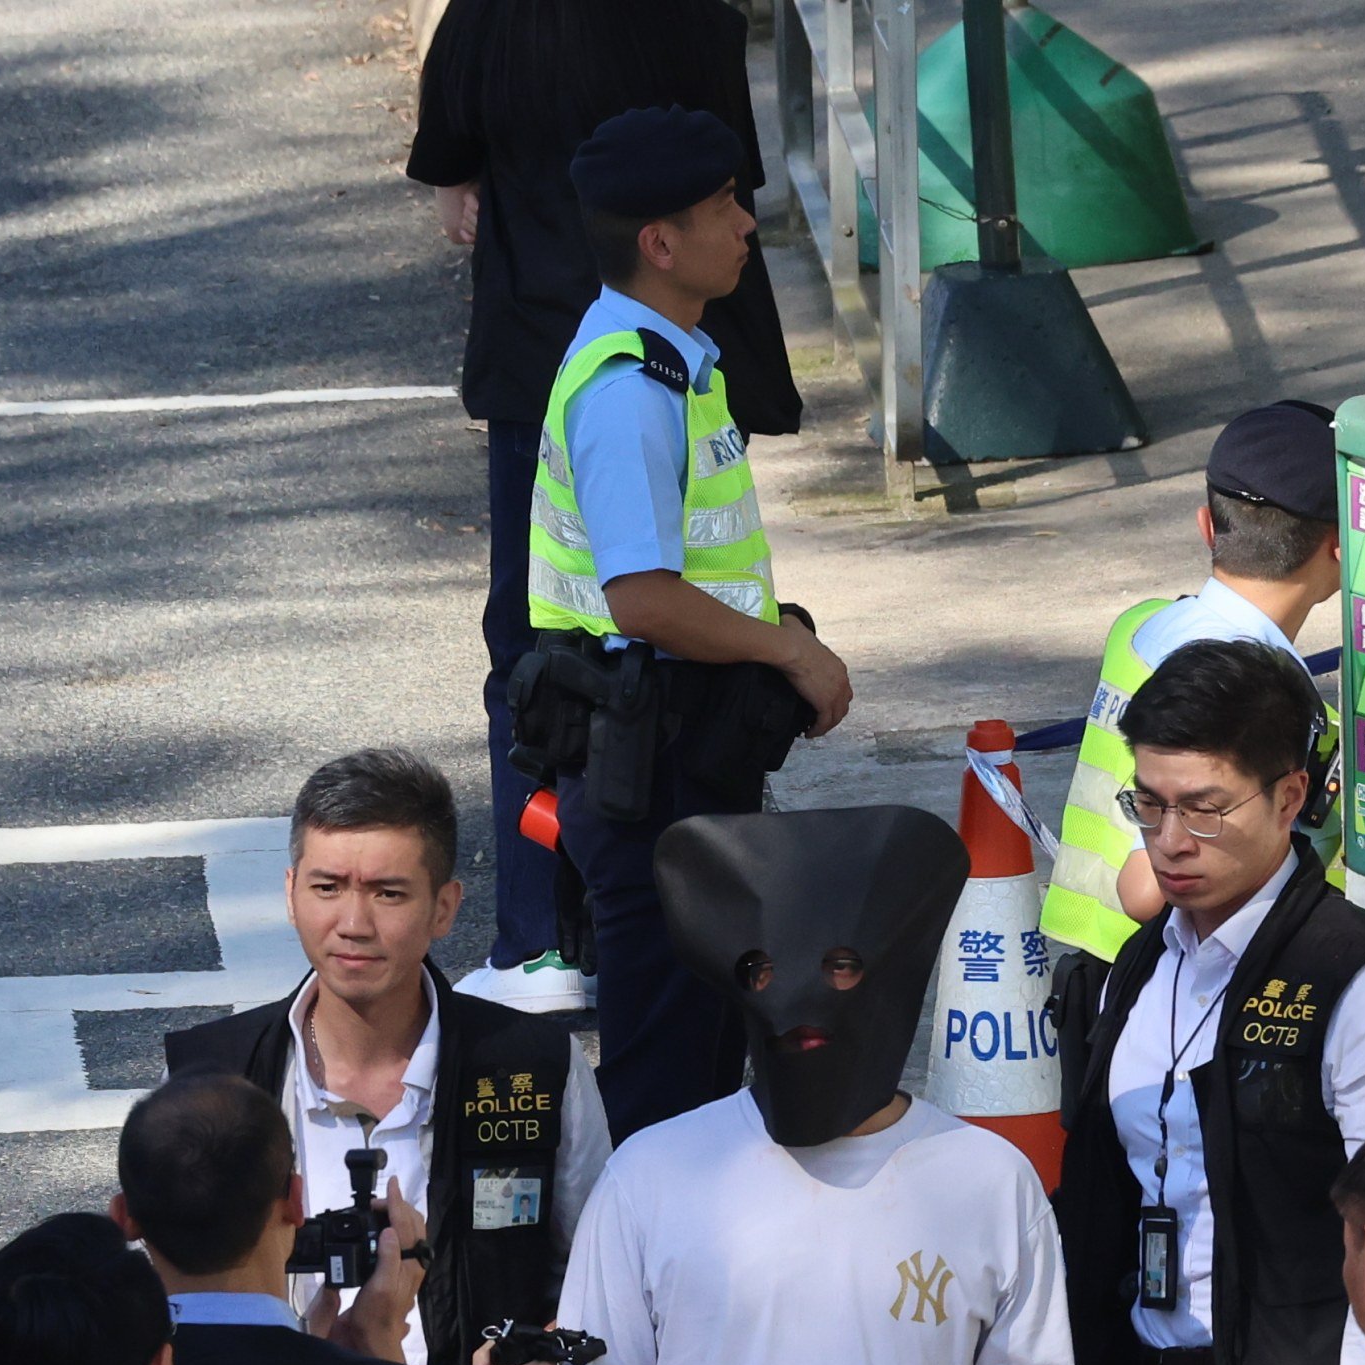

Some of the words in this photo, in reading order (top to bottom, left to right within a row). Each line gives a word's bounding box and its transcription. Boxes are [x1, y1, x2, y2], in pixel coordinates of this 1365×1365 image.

[649, 360, 684, 382] 61135
[1242, 997, 1317, 1021] POLICE
[1243, 1022, 1299, 1047] OCTB
[465, 1094, 551, 1117] POLICE
[478, 1120, 540, 1142] OCTB
[889, 1249, 955, 1328] NY
